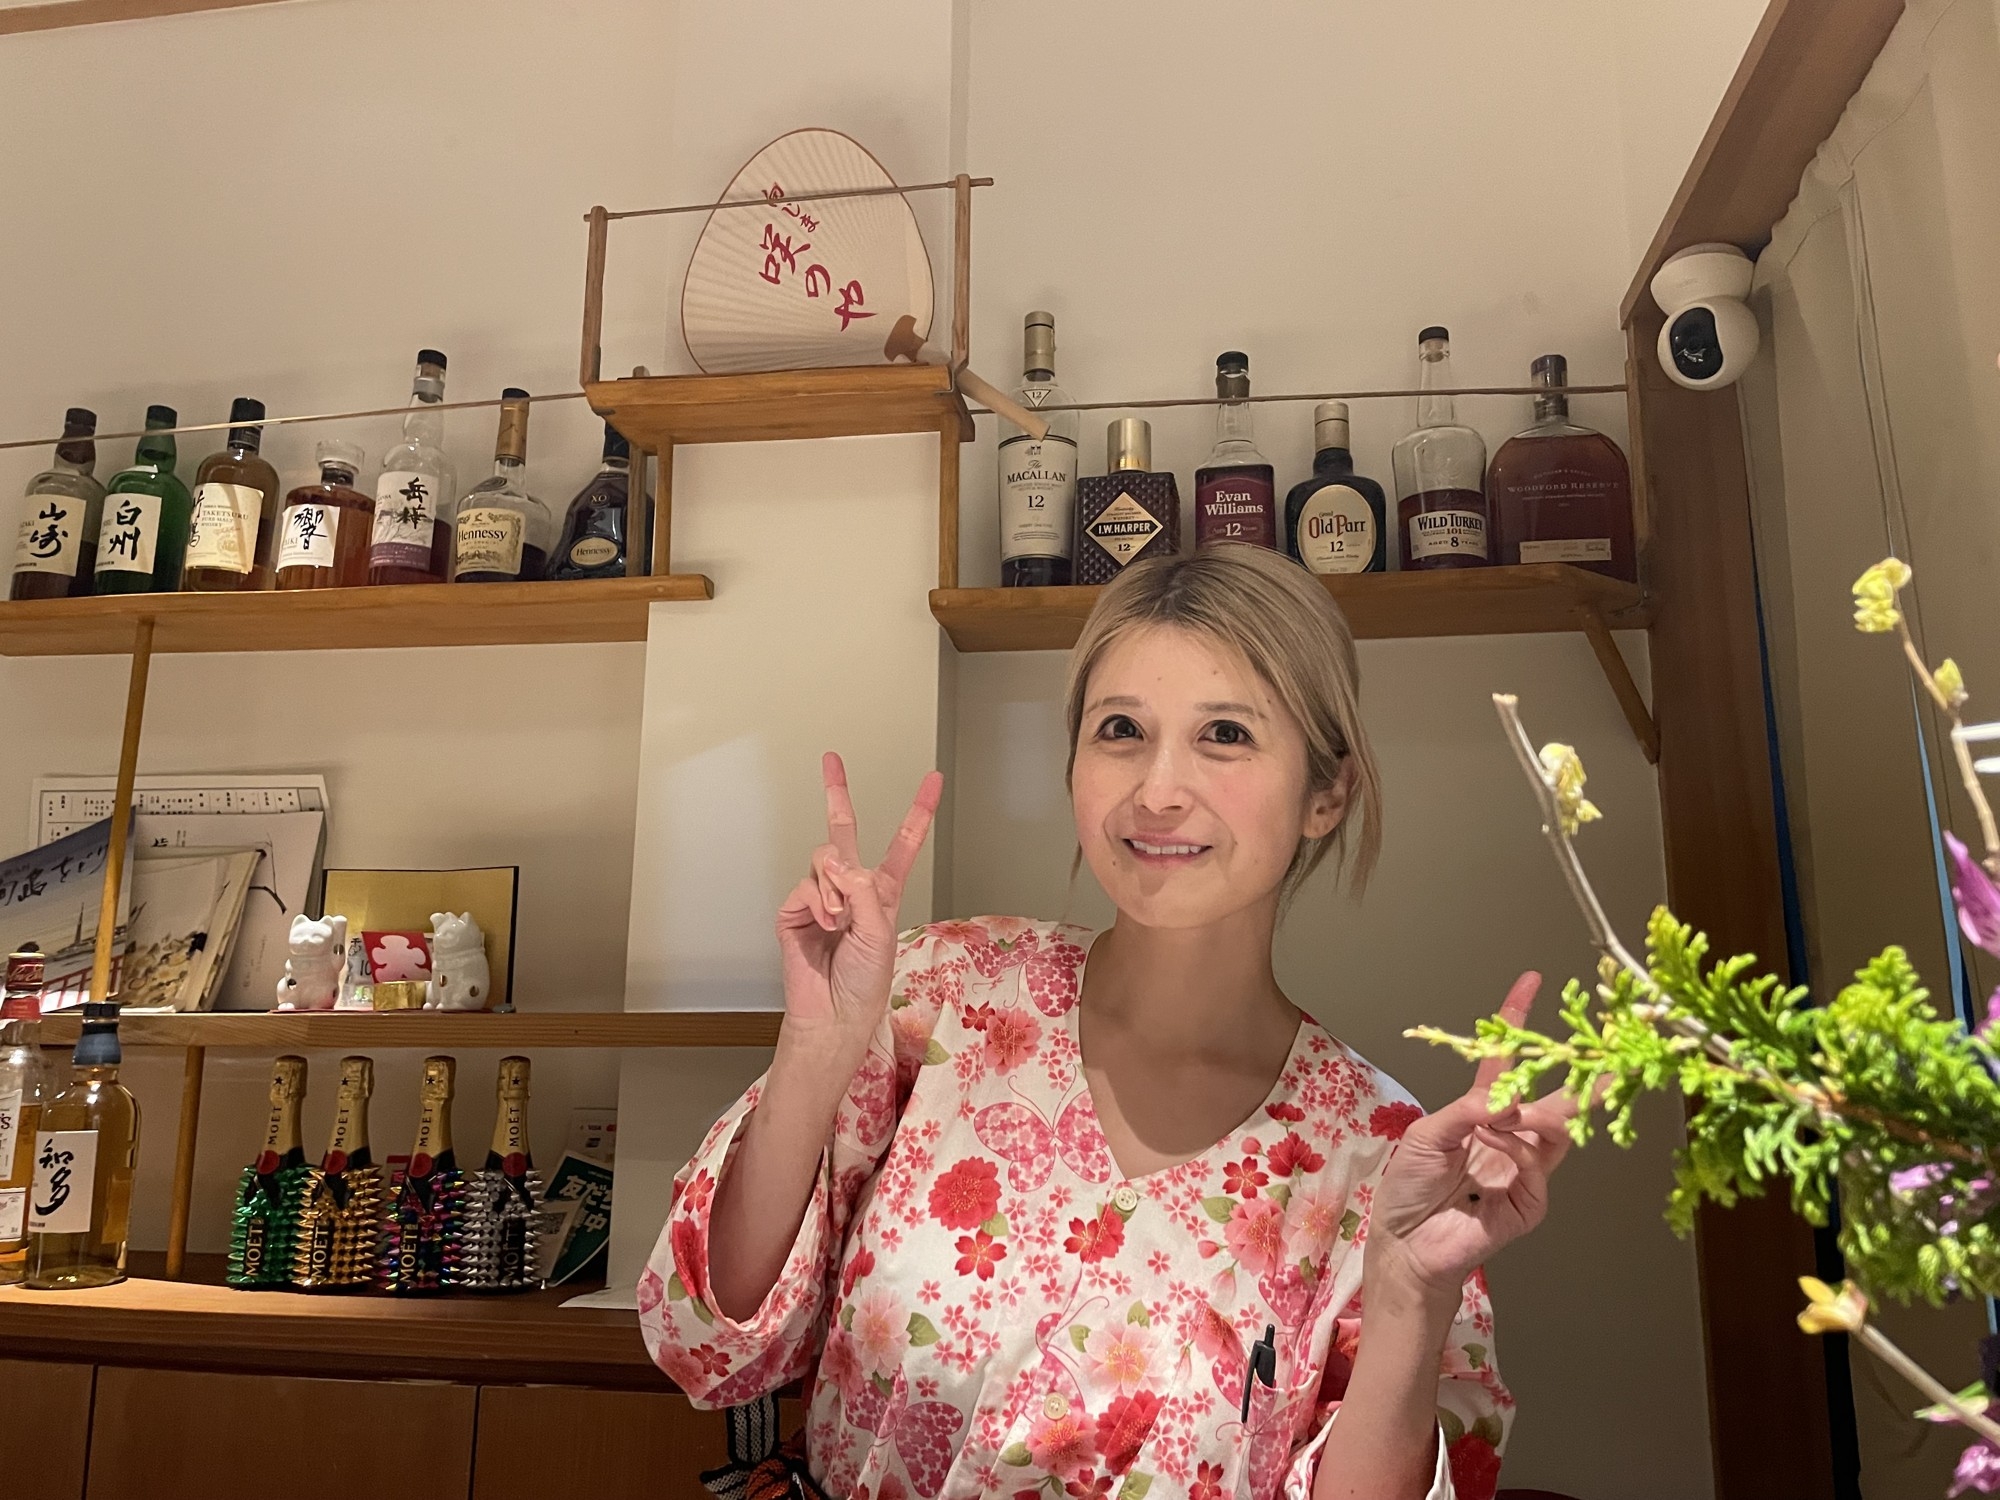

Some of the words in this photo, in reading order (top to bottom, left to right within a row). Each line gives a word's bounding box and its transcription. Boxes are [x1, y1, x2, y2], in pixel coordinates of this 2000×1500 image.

[1032, 391, 1042, 399] 12
[1007, 470, 1067, 484] MACALLAN
[1028, 494, 1045, 509] 12
[1215, 490, 1252, 503] Evan
[202, 510, 249, 520] TAKETSURU
[1204, 502, 1264, 516] Williams
[293, 507, 328, 550] 響
[1225, 522, 1242, 537] 12
[1308, 516, 1334, 539] Old
[1333, 514, 1366, 538] Parr
[1417, 515, 1448, 531] WILD
[107, 500, 142, 561] 白州
[458, 529, 508, 543] Hennessy
[1446, 527, 1463, 535] 101
[1117, 543, 1131, 552] 12
[1330, 540, 1344, 553] 12
[1450, 536, 1460, 548] 8
[576, 547, 611, 557] Hennessy
[35, 1138, 75, 1217] 知多
